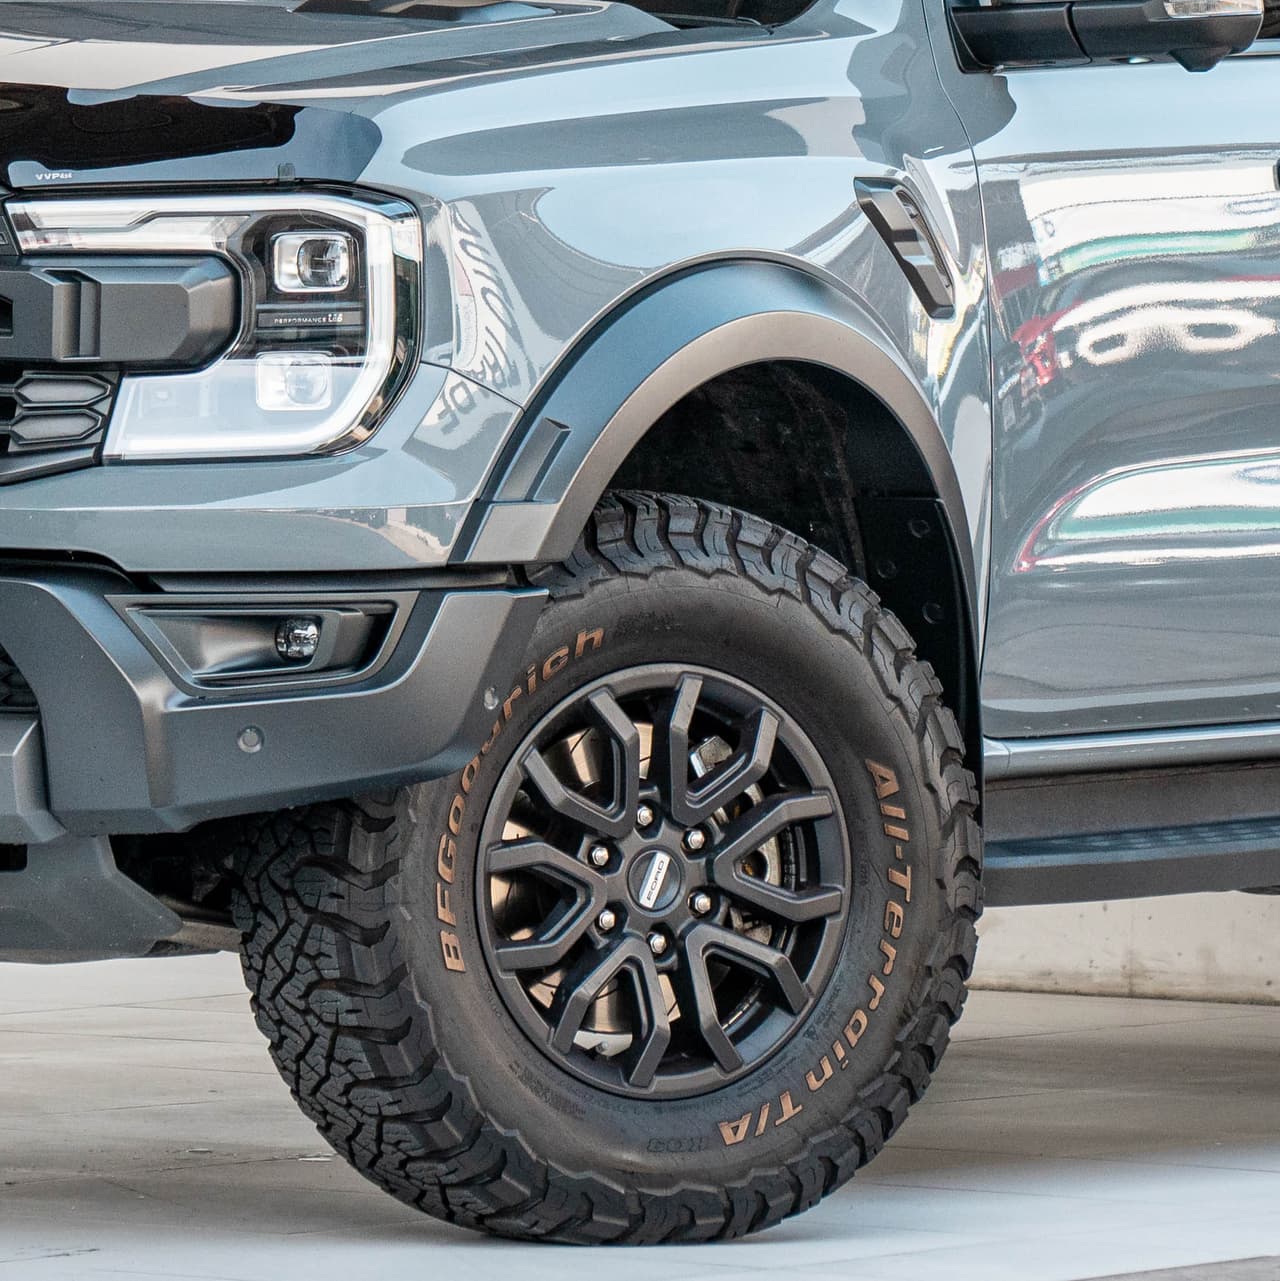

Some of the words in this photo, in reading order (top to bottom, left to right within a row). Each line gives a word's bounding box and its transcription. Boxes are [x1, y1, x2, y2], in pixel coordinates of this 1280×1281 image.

[646, 860, 665, 901] FORD
[805, 758, 912, 1092] All-Terrain
[718, 1090, 803, 1146] T/A
